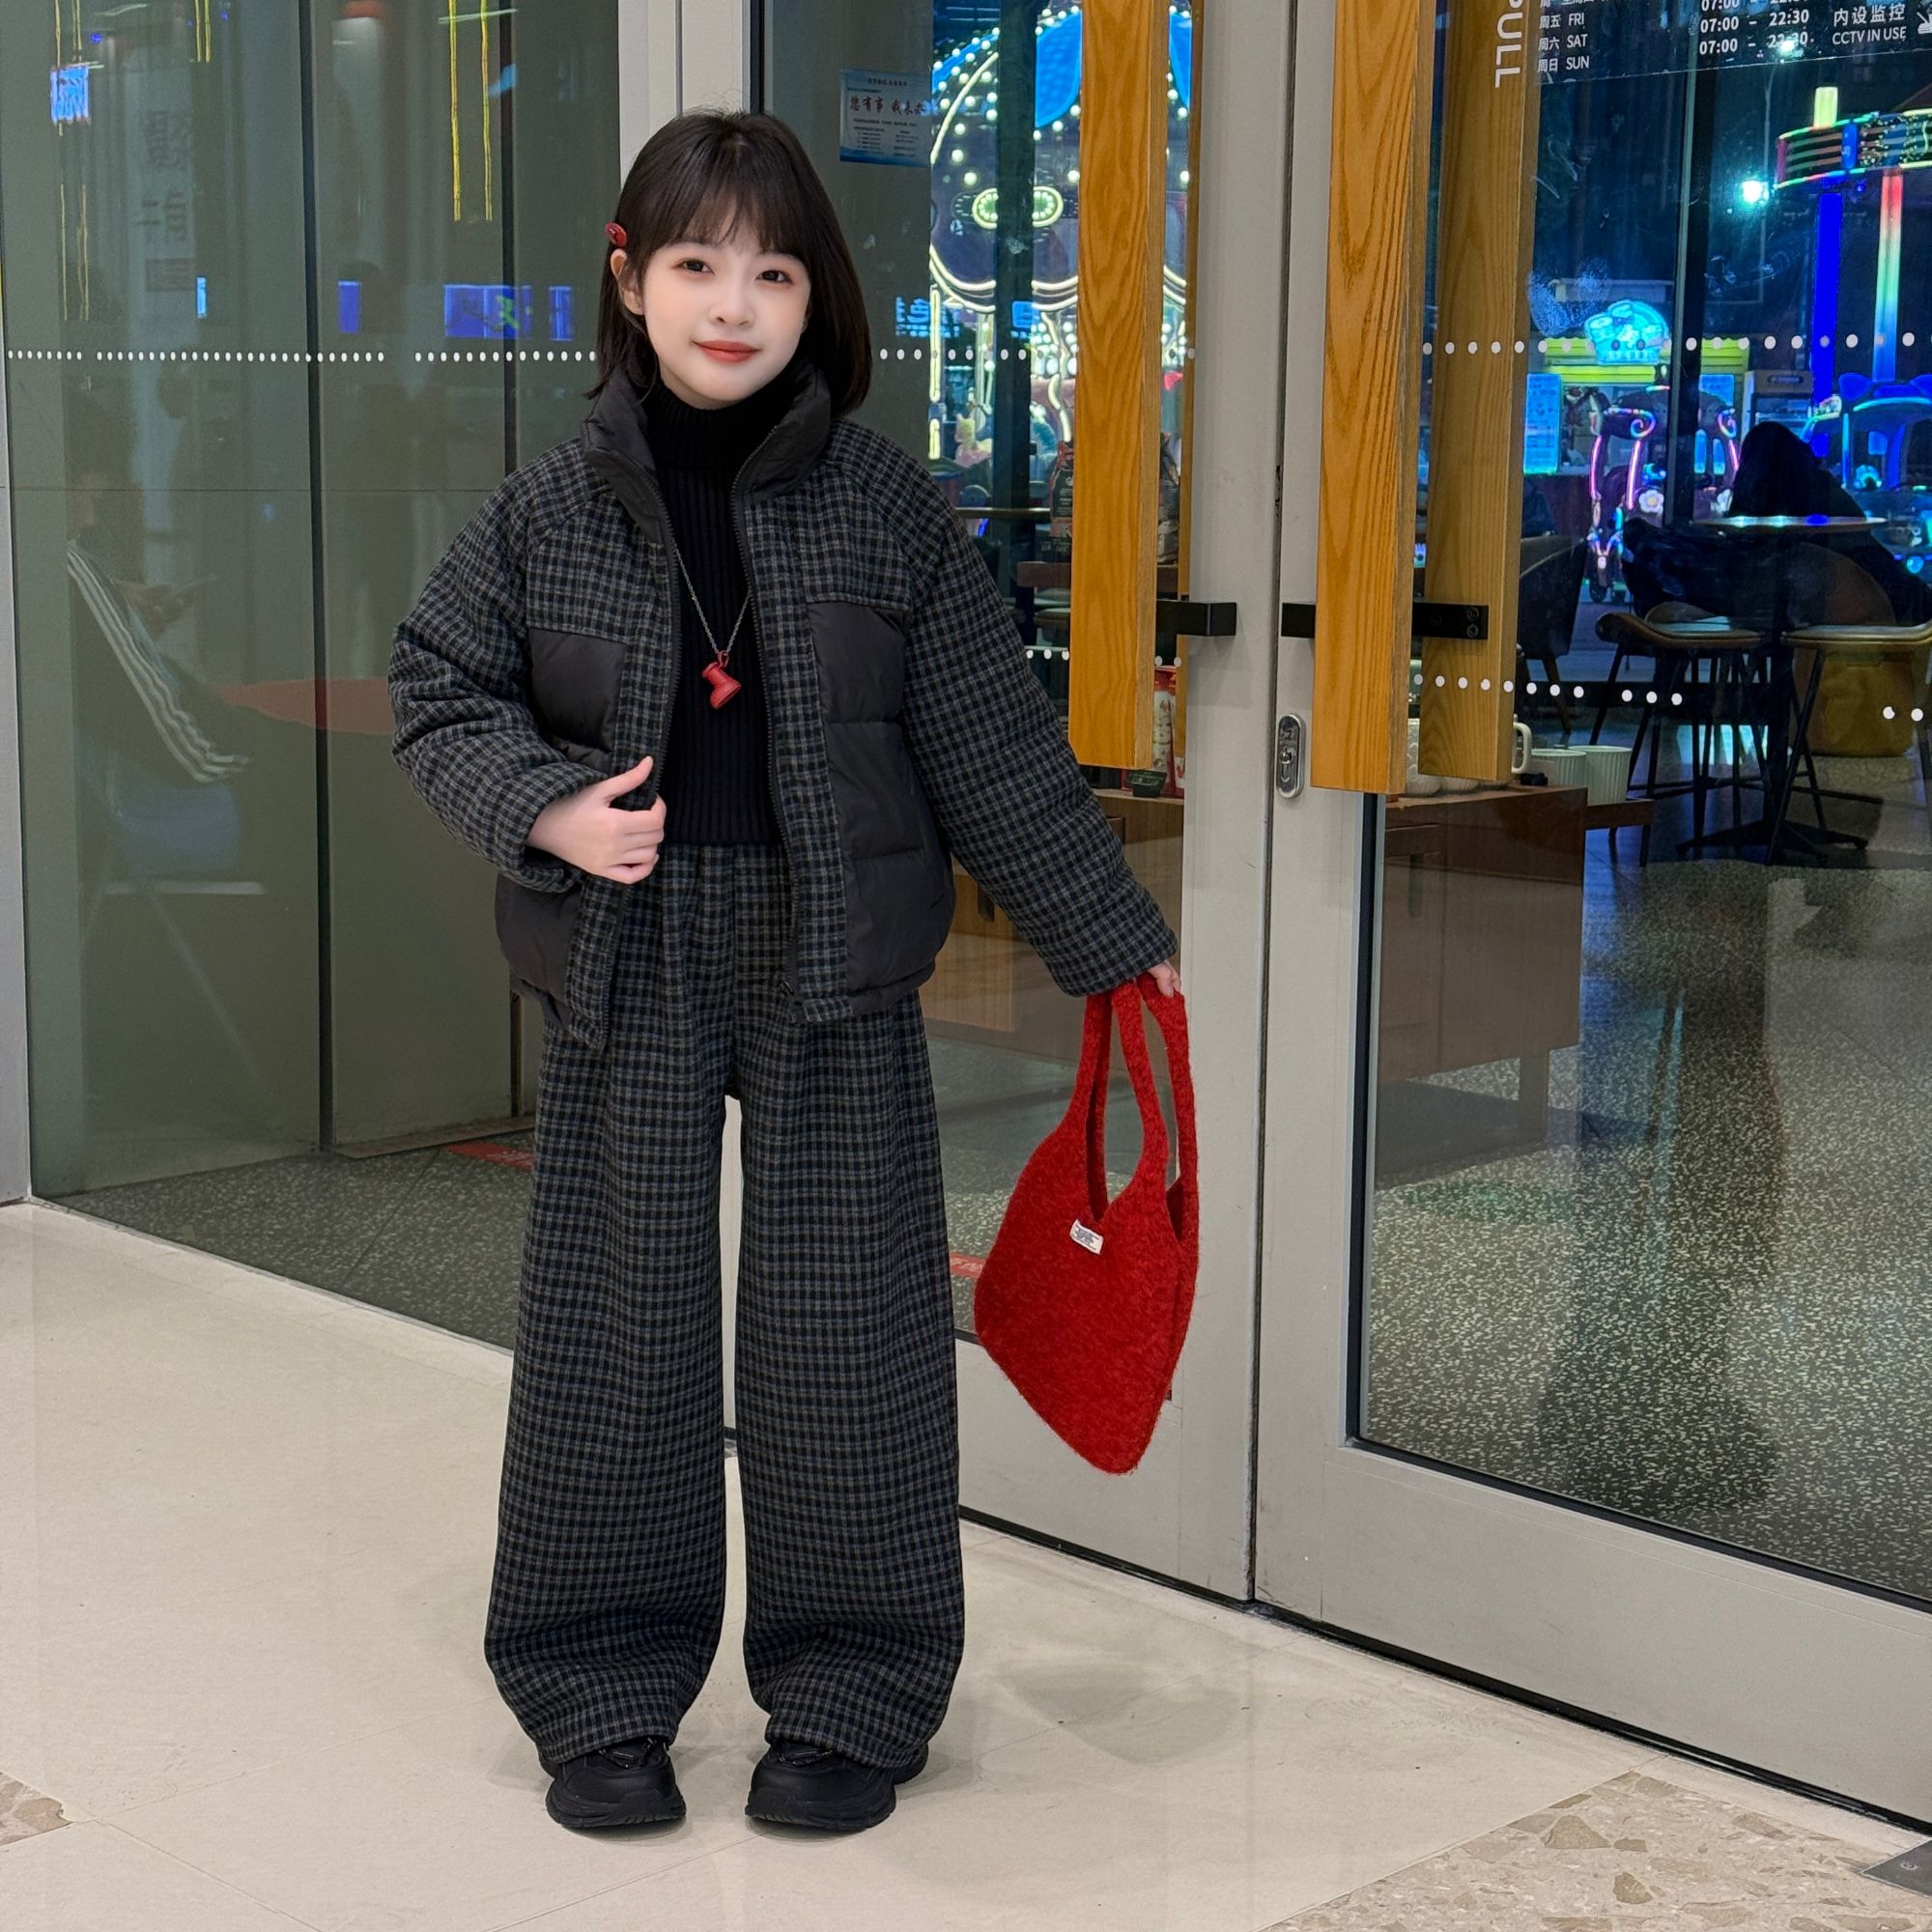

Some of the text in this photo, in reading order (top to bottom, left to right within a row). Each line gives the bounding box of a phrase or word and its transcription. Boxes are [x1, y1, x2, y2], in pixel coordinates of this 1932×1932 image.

[1539, 14, 1561, 29] 周五
[1568, 13, 1585, 26] FRI
[1833, 4, 1906, 27] 内设监控
[1538, 37, 1560, 51] 周六
[1567, 34, 1588, 48] SAT
[1700, 16, 1739, 34] 07:00
[1769, 10, 1809, 27] 22:30
[1832, 26, 1907, 45] CCTV IN USE
[1537, 58, 1558, 73] 周日
[1566, 55, 1590, 71] SUN
[1699, 39, 1738, 55] 07:00
